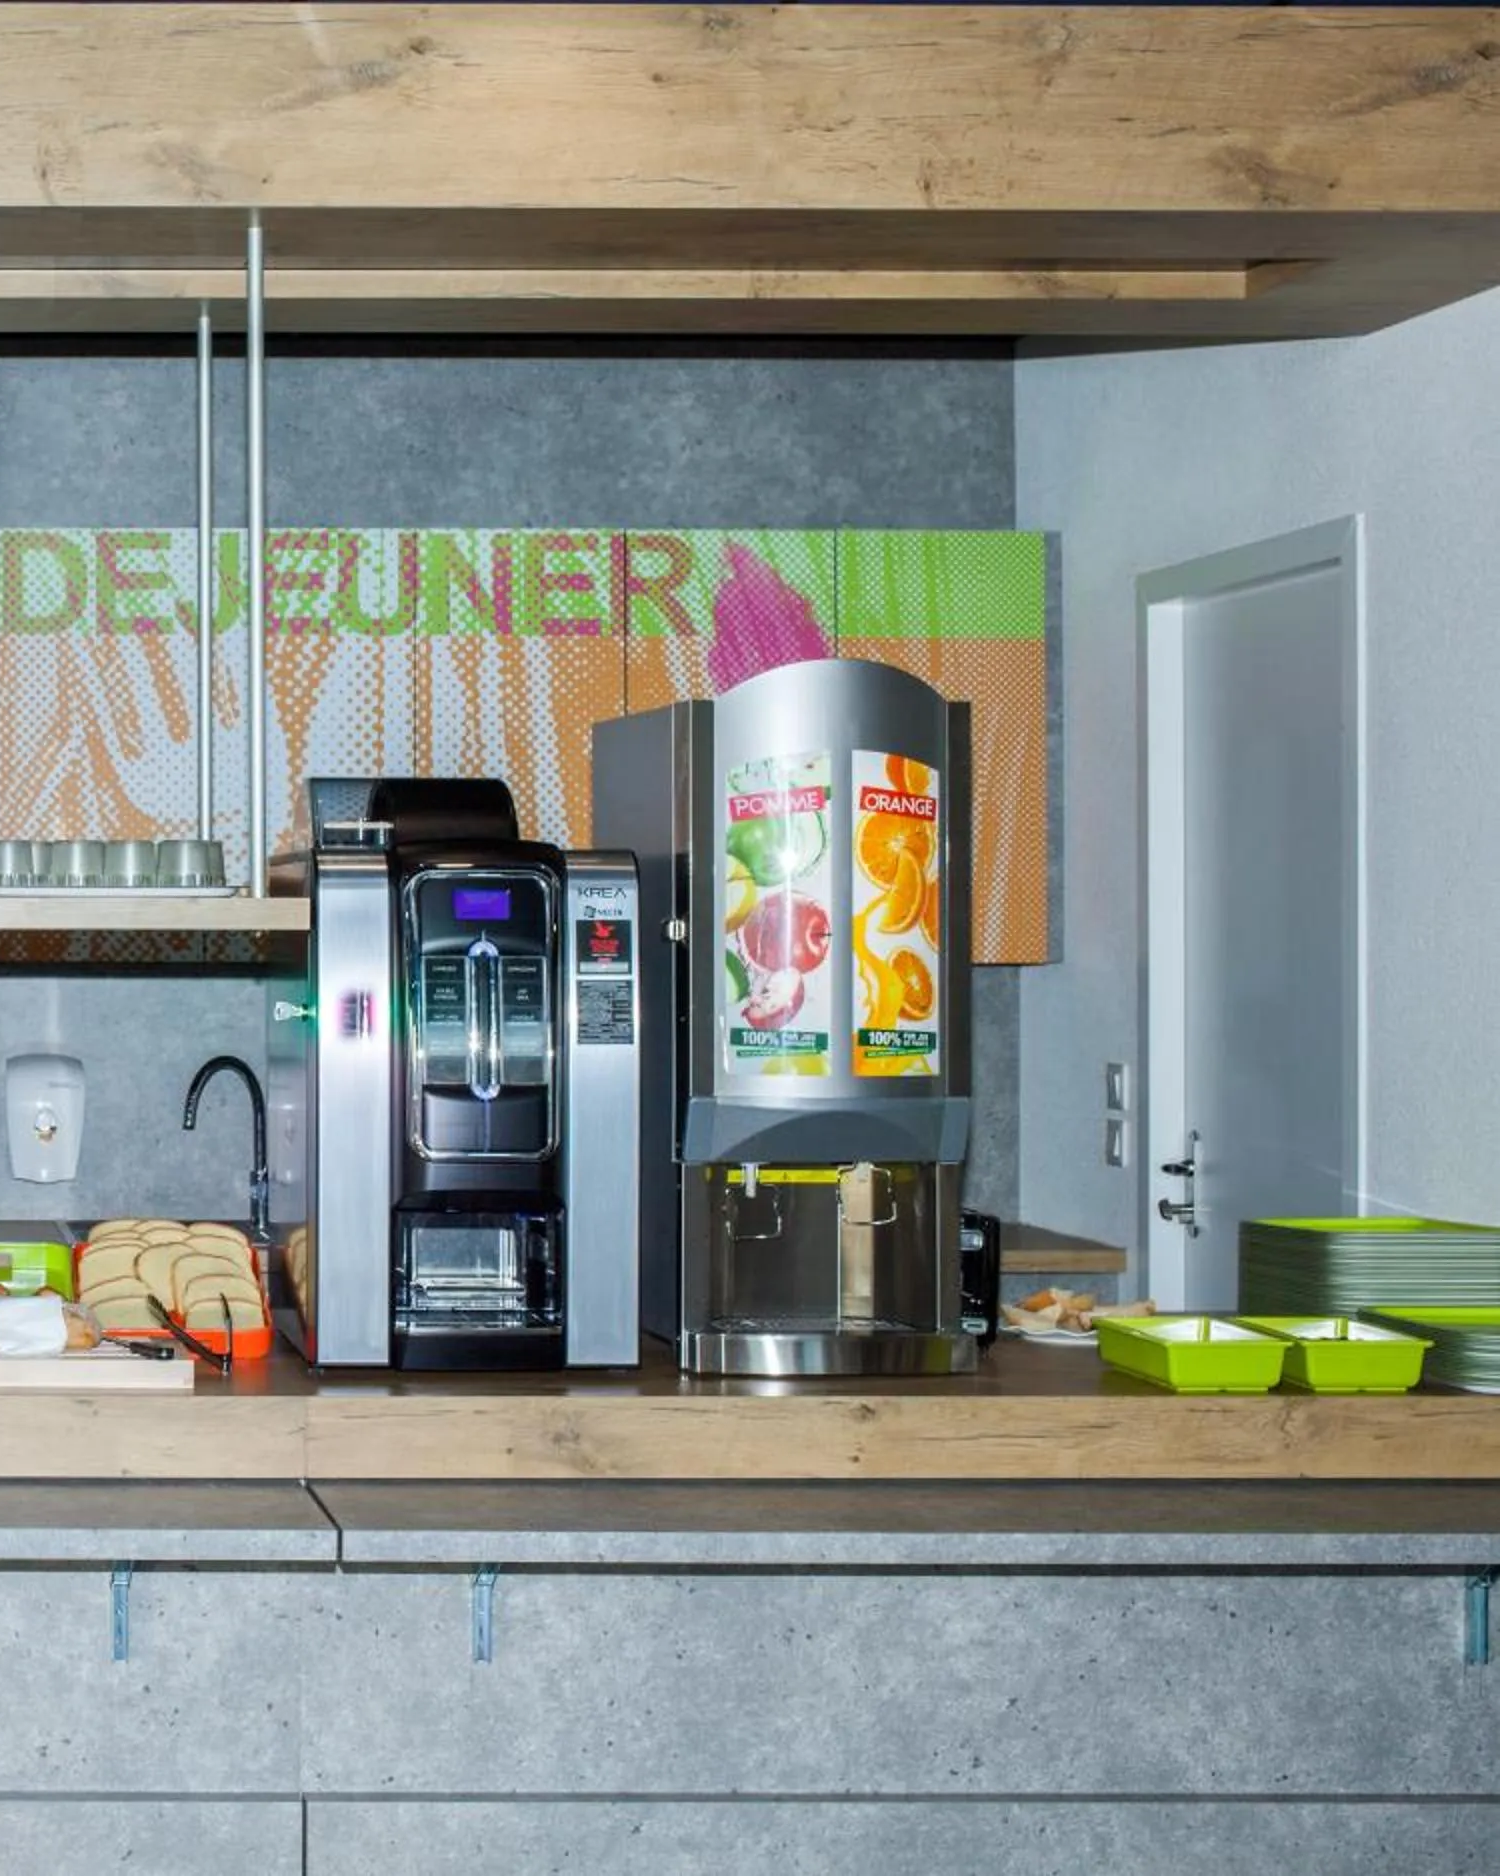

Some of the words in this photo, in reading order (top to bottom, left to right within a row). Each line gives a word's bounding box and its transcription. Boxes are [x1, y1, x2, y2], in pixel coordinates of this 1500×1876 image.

[864, 792, 934, 817] ORANGE
[578, 886, 627, 899] KREA
[742, 1030, 780, 1047] 100%
[868, 1030, 902, 1047] 100%
